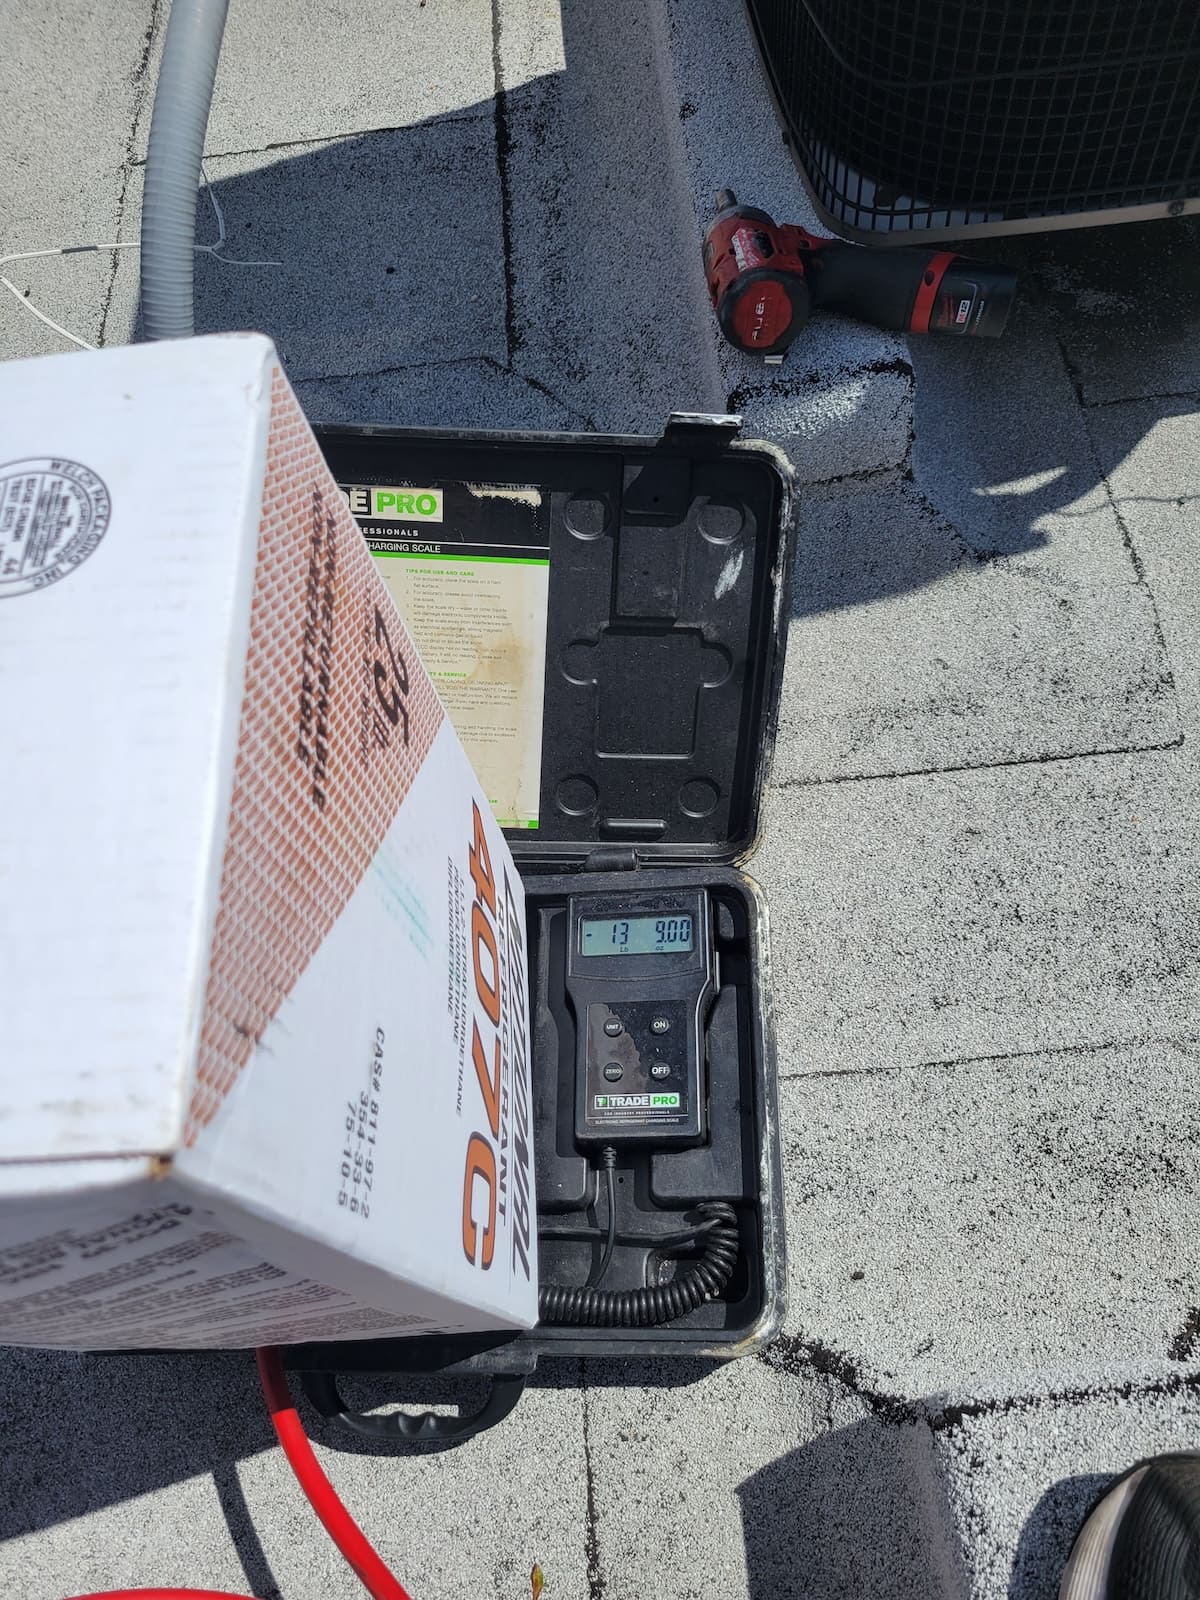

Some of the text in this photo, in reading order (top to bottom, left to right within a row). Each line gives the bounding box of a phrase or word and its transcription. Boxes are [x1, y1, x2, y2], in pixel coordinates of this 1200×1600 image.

[358, 526, 419, 537] ESSIONALS
[376, 492, 438, 516] PRO
[368, 541, 441, 553] HARGING SCALE
[447, 855, 455, 1017] DIFLUOROMETHANE
[453, 864, 462, 1046] PENTAFLUOROETHANE
[612, 921, 630, 946] 13
[656, 919, 691, 944] 9.00
[462, 796, 502, 1272] 407C
[653, 1020, 666, 1030] ON
[496, 892, 509, 1227] REFRIGERANT
[504, 858, 531, 1283] NATIONAL
[605, 1067, 621, 1075] ZERO
[651, 1066, 670, 1075] OFF
[361, 1026, 386, 1219] CAS# 811-97-2
[610, 1095, 679, 1107] TRADE PRO
[337, 1101, 357, 1208] 75-10-5
[349, 1090, 369, 1215] 354-33-6
